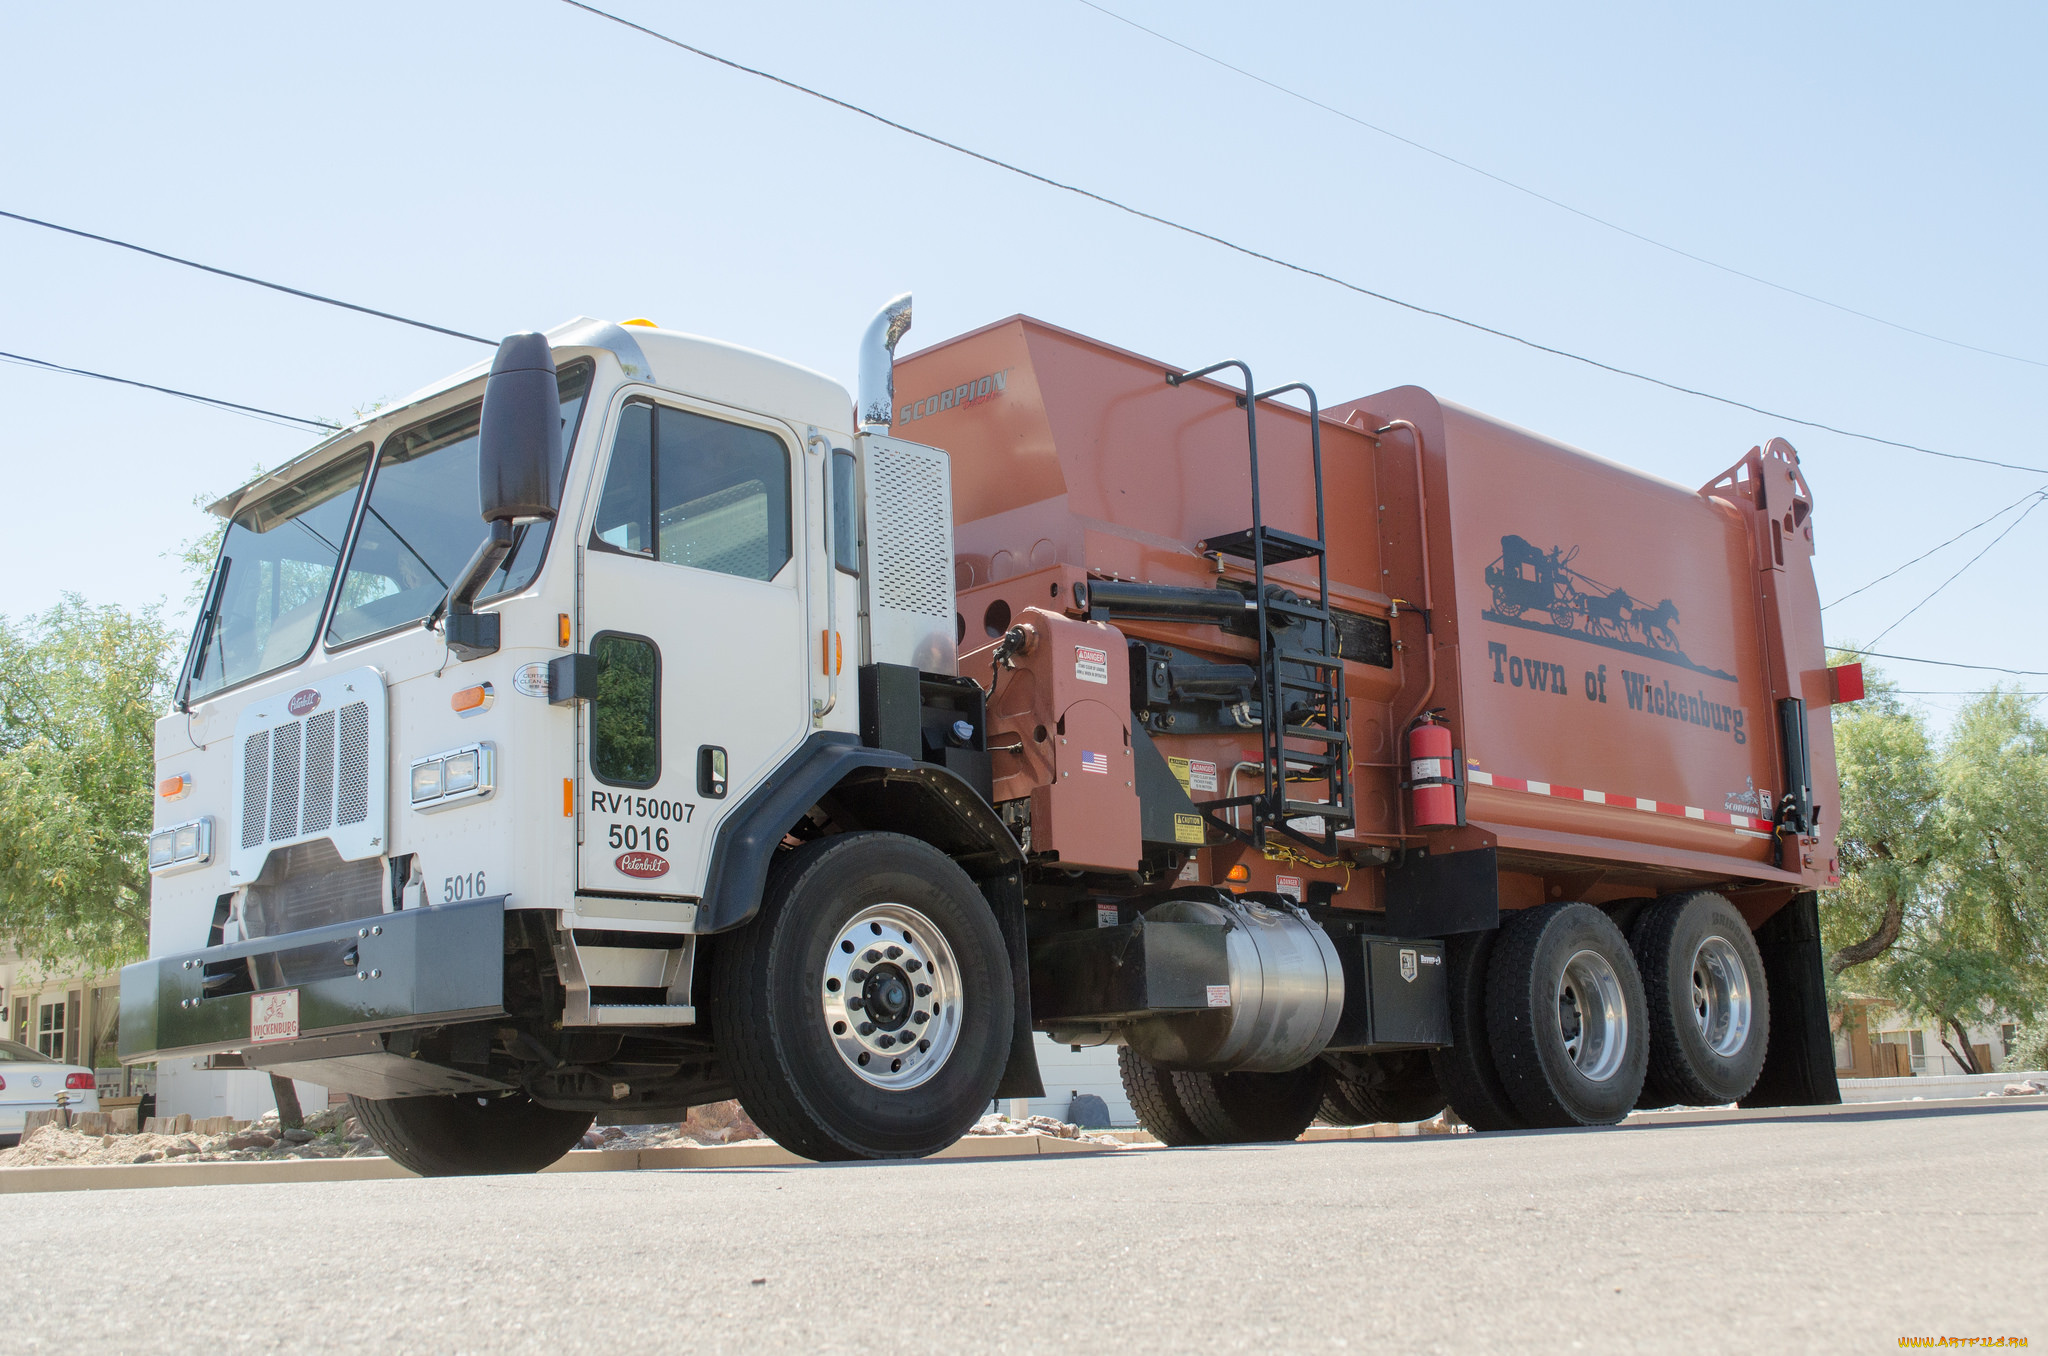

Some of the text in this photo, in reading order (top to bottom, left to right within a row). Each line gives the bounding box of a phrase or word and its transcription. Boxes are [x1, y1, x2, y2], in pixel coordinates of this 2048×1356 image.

[900, 368, 1008, 426] SCORPION
[1083, 650, 1104, 663] DANGER
[1488, 641, 1746, 745] Town of Wickenburg
[591, 790, 696, 823] RV150007
[1724, 801, 1760, 815] SCORPION
[609, 824, 670, 852] 5016
[621, 855, 666, 873] Peterbilt
[444, 870, 487, 902] 5016
[253, 1020, 297, 1037] WICKENBURG
